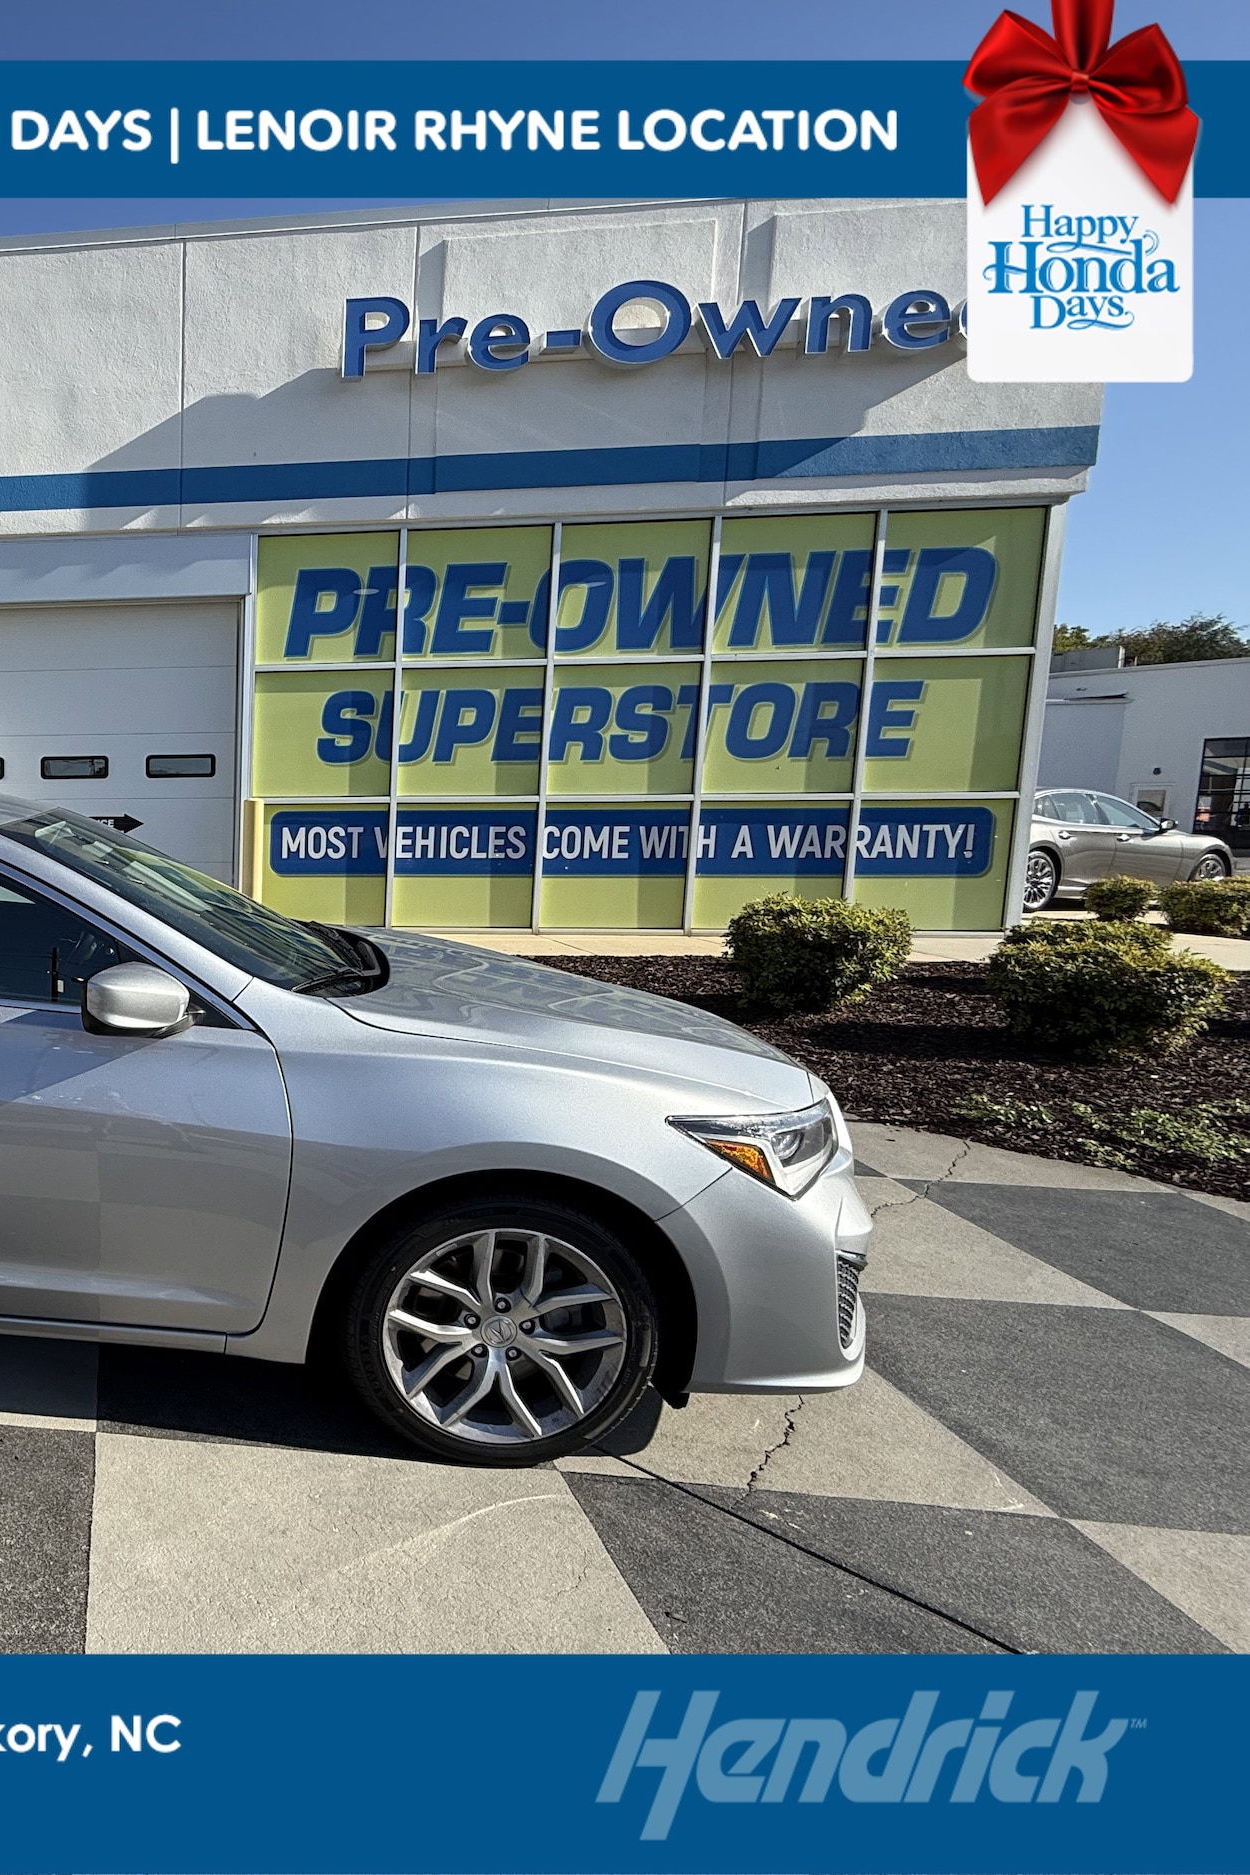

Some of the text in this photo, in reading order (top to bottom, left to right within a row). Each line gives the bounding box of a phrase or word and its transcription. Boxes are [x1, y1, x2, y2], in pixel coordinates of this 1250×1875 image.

[340, 280, 966, 380] Pre-Owne
[283, 546, 1000, 657] PRE-OWNED
[316, 680, 926, 764] SUPERSTORE
[281, 823, 975, 860] MOST VEHICLES COME WITH A WARRANTY!
